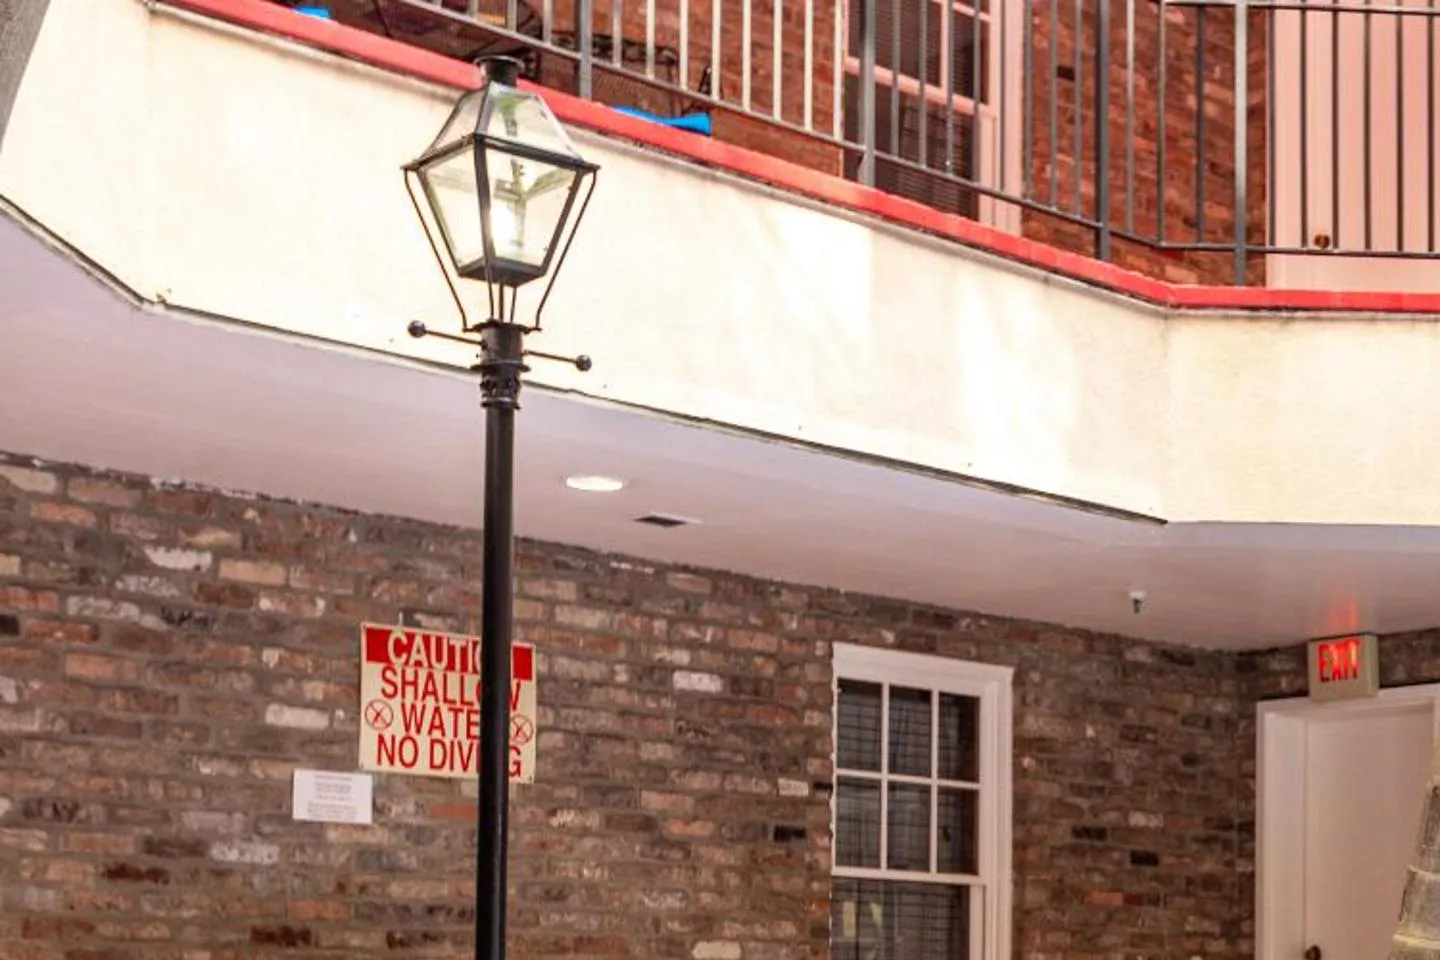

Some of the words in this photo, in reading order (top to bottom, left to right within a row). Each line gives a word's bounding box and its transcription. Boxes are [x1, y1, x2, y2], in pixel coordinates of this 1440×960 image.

[387, 630, 482, 674] CAUTI
[381, 665, 521, 712] SHALL
[401, 702, 481, 740] WATE
[376, 733, 420, 769] NO
[429, 737, 522, 777] DIVIG
